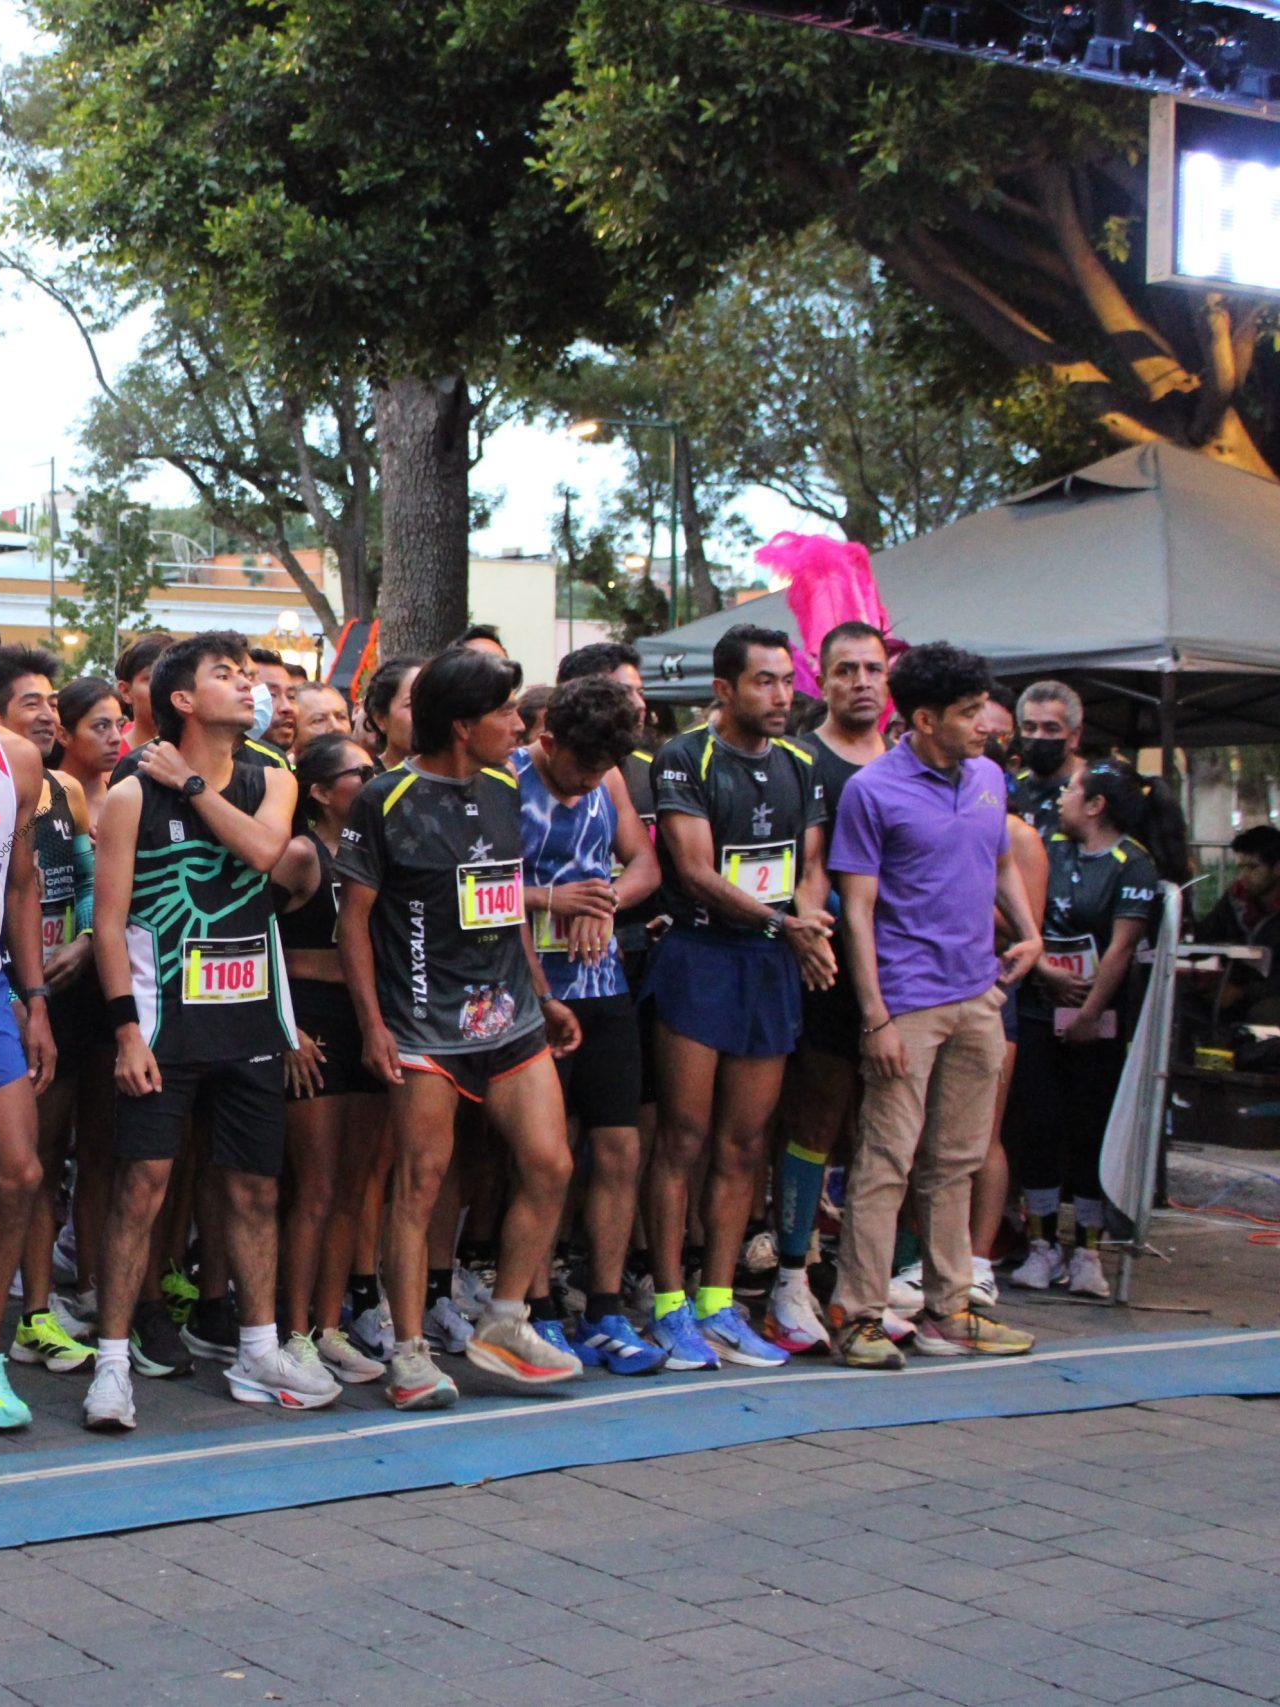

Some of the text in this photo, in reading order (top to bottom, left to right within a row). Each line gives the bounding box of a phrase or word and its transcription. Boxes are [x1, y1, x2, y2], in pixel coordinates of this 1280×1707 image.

[756, 866, 771, 892] 2
[475, 884, 515, 915] 1140
[410, 916, 428, 1003] TLAXCALA
[201, 960, 255, 990] 1108
